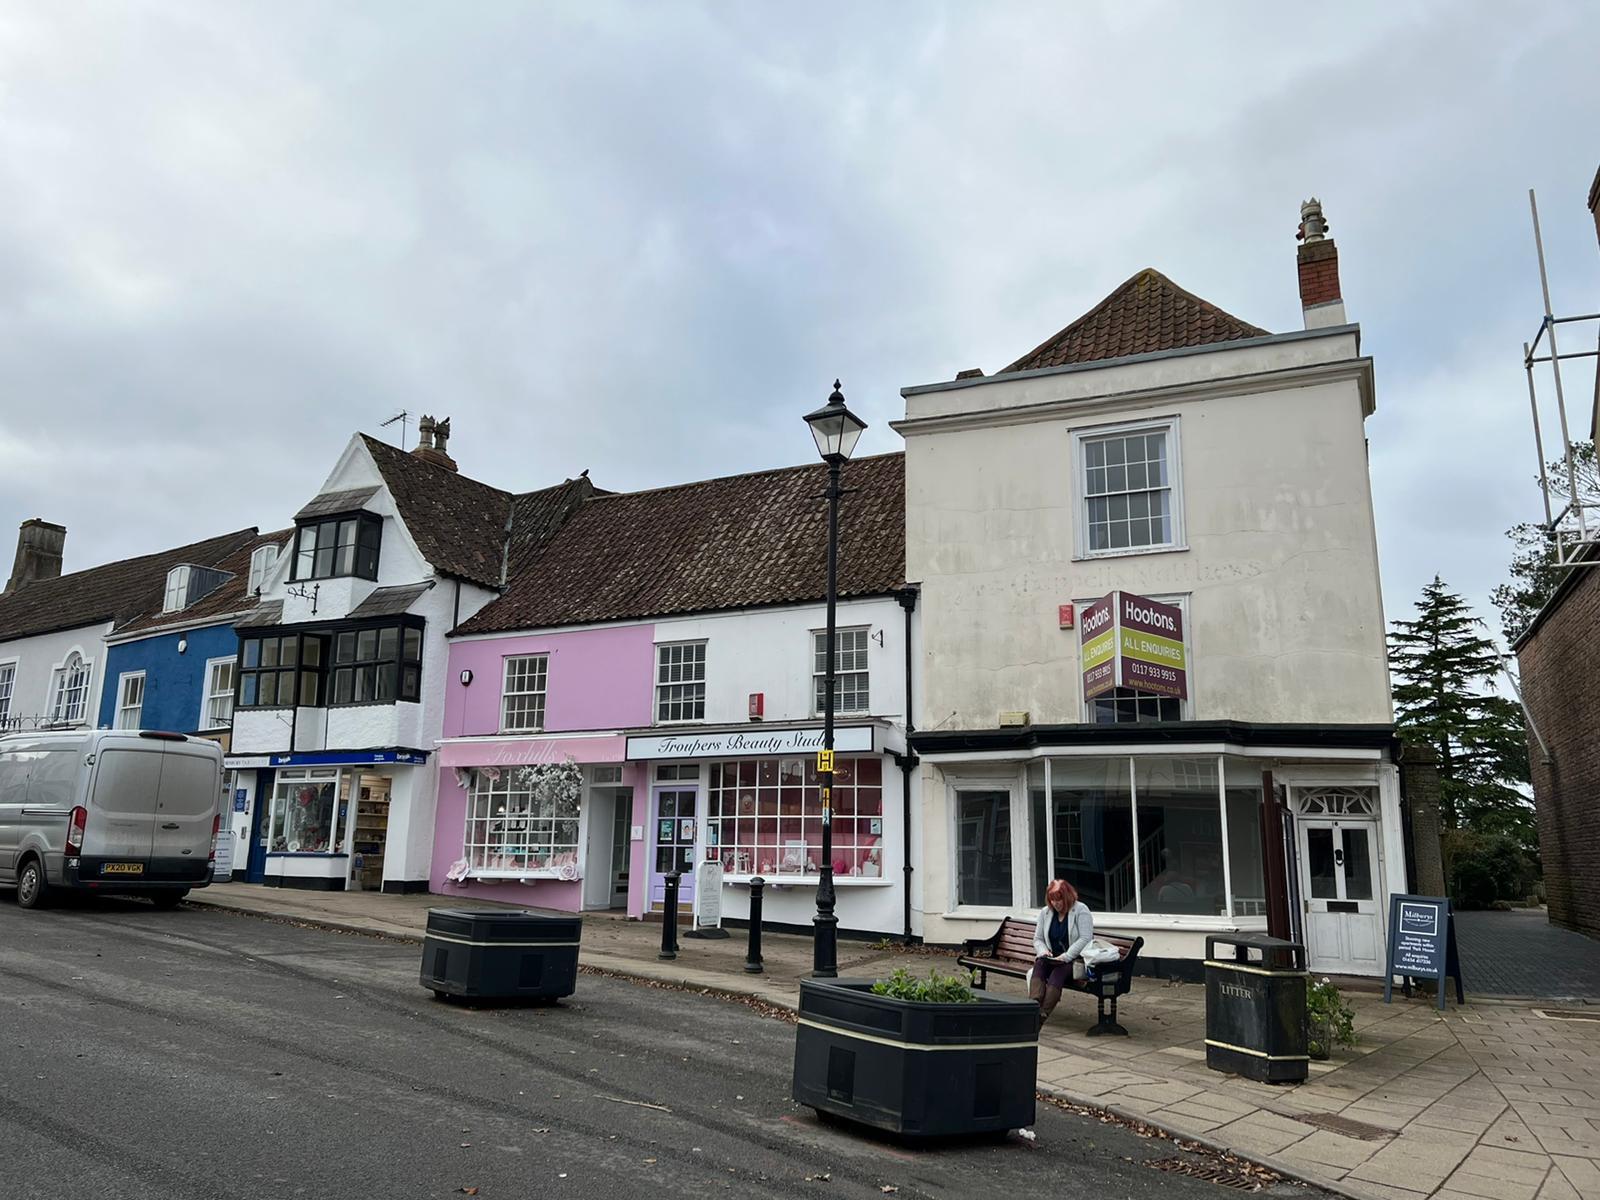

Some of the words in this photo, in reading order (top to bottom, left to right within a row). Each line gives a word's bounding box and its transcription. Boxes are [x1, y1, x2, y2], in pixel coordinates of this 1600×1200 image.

[1124, 637, 1140, 650] ALL
[1141, 642, 1181, 660] ENQUIRIES
[1132, 663, 1148, 675] 0117
[1149, 666, 1160, 678] 933
[1161, 670, 1176, 681] 9915
[658, 738, 721, 755] Troupers
[727, 733, 782, 752] Beauty
[787, 731, 835, 747] Stud
[820, 751, 831, 769] H
[105, 863, 126, 871] PX20
[1404, 911, 1433, 920] Milburys
[1221, 985, 1251, 999] LITTER
